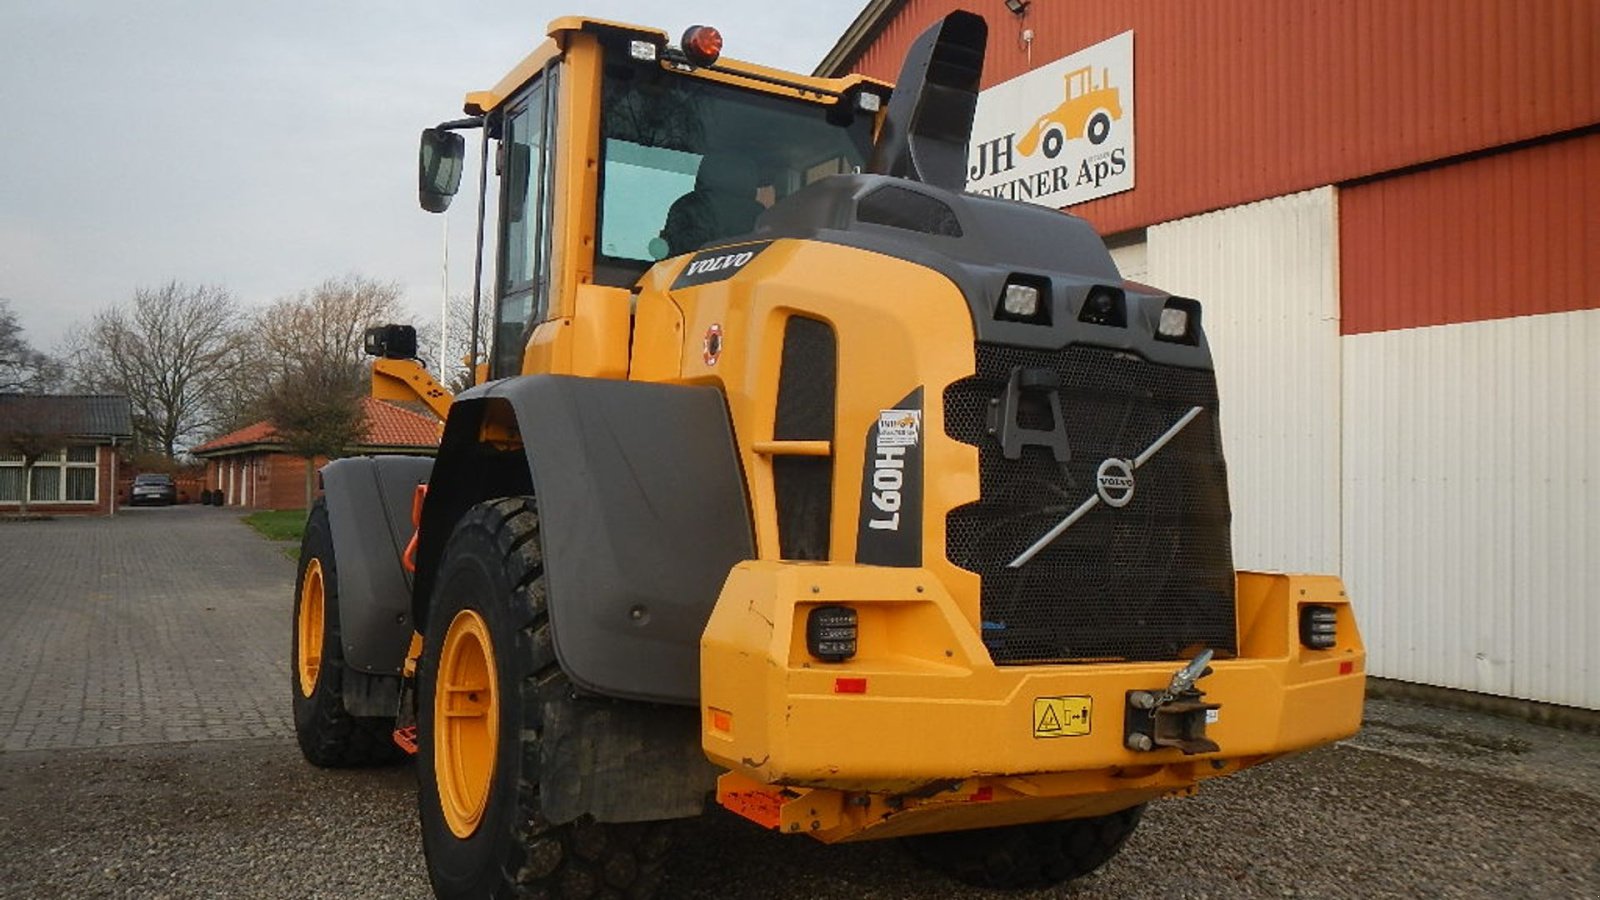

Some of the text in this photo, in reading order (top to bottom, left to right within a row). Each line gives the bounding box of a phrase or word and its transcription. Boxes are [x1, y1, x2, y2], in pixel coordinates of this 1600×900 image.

[965, 133, 1016, 182] JH
[1075, 147, 1126, 188] ApS
[686, 251, 753, 276] VOLVO
[869, 447, 905, 530] L60H
[1099, 477, 1133, 487] VOLVO
